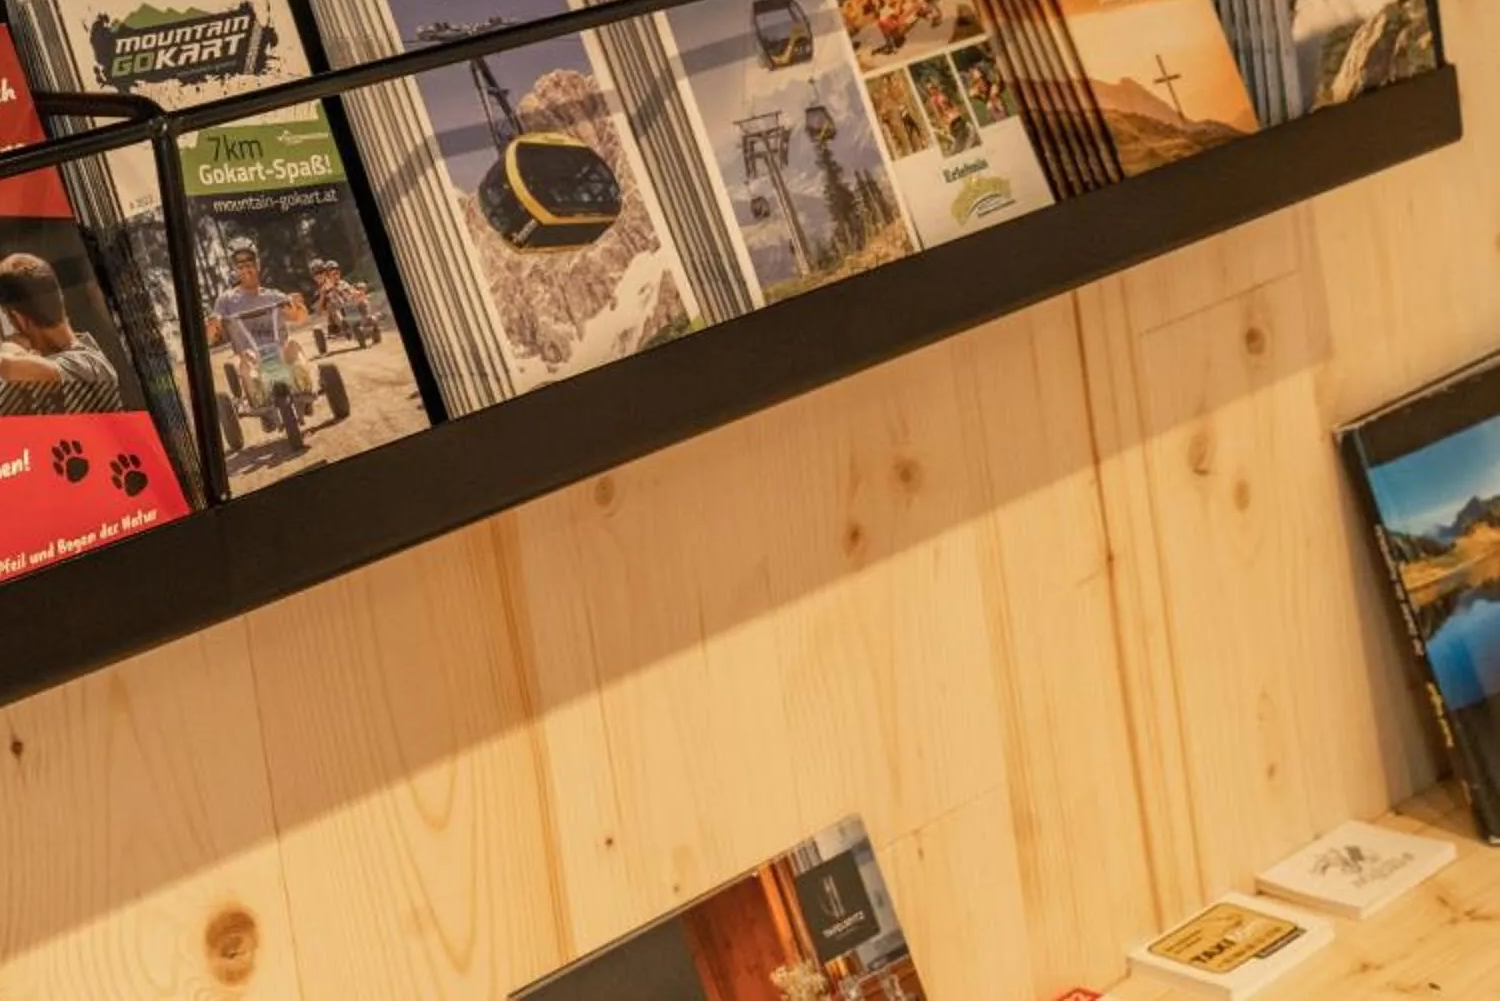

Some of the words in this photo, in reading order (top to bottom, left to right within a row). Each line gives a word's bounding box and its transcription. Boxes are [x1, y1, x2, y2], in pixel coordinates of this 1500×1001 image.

[111, 33, 247, 78] GOKART
[207, 134, 264, 163] 7km
[199, 153, 333, 186] Gokart-Spaß!
[212, 188, 339, 214] mountain-gokart.at
[29, 542, 56, 566] und
[57, 532, 98, 555] Bogen
[100, 522, 119, 540] der
[121, 508, 158, 531] Natur
